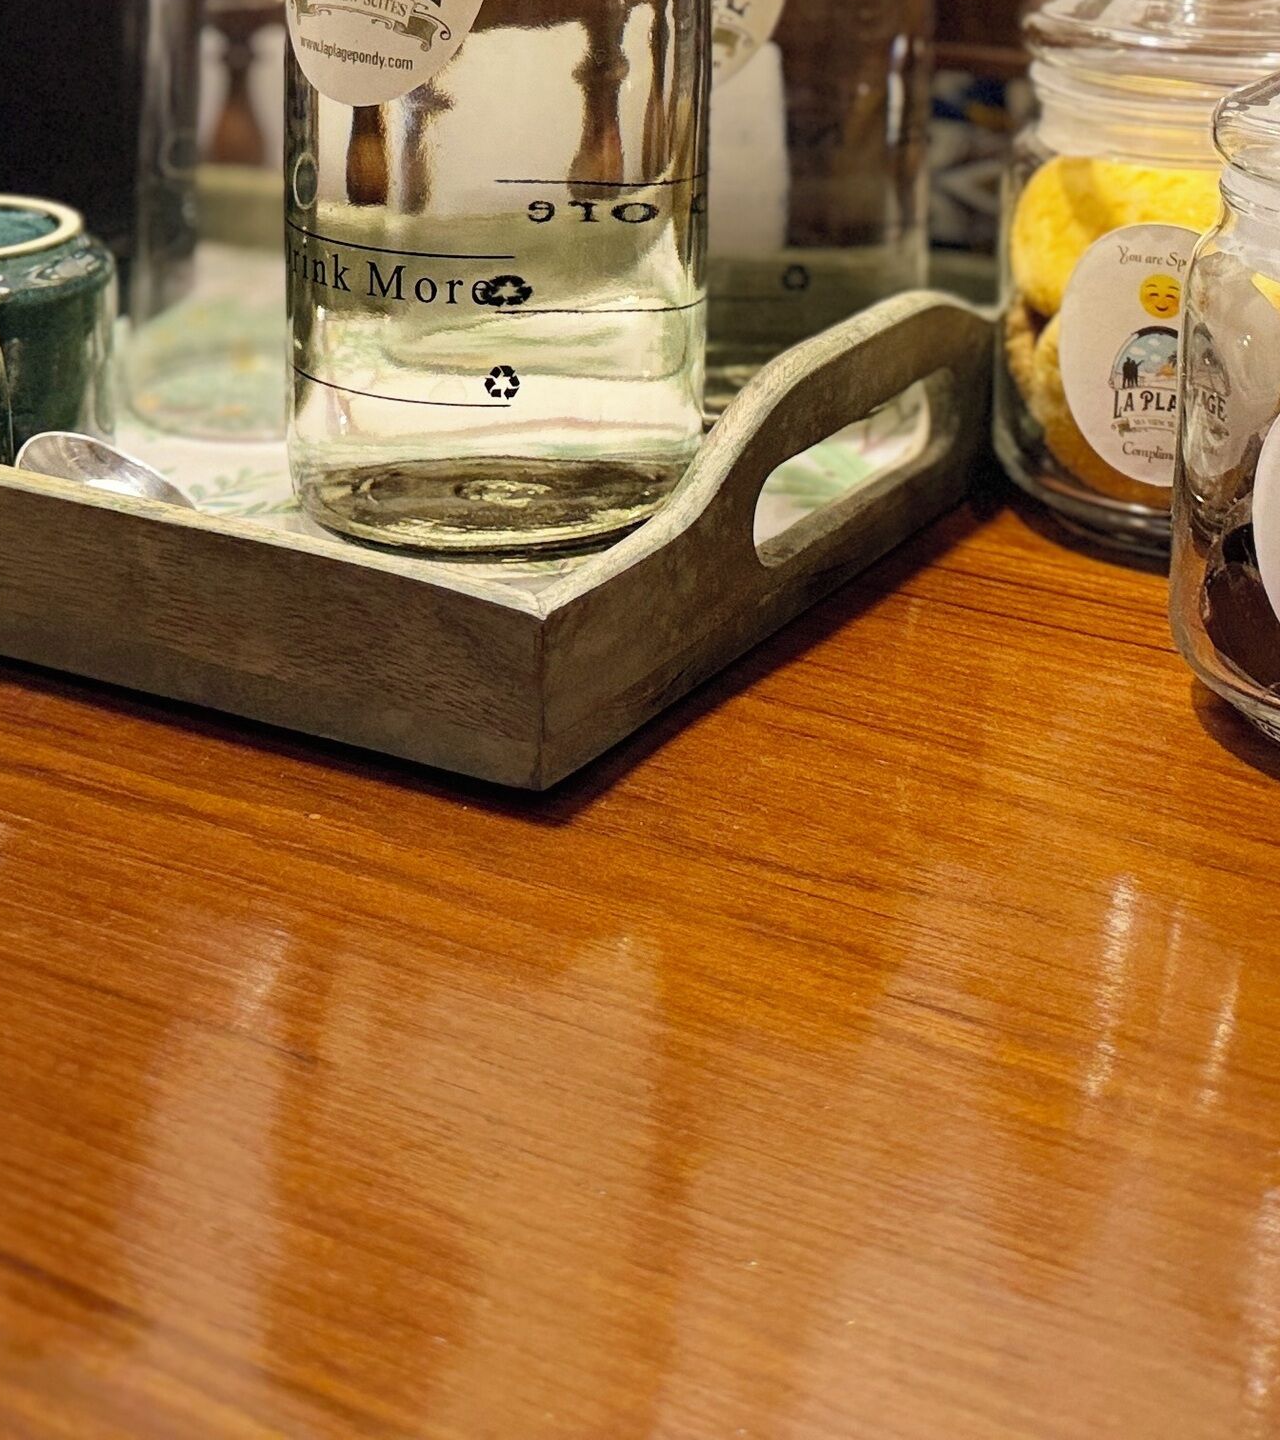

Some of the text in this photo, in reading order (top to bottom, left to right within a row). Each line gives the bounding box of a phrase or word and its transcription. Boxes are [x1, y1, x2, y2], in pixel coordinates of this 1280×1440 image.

[300, 35, 414, 71] www.laplagepondy.com
[1118, 244, 1142, 265] You
[1145, 255, 1163, 266] are
[289, 243, 493, 307] rink More
[1113, 390, 1135, 419] LA
